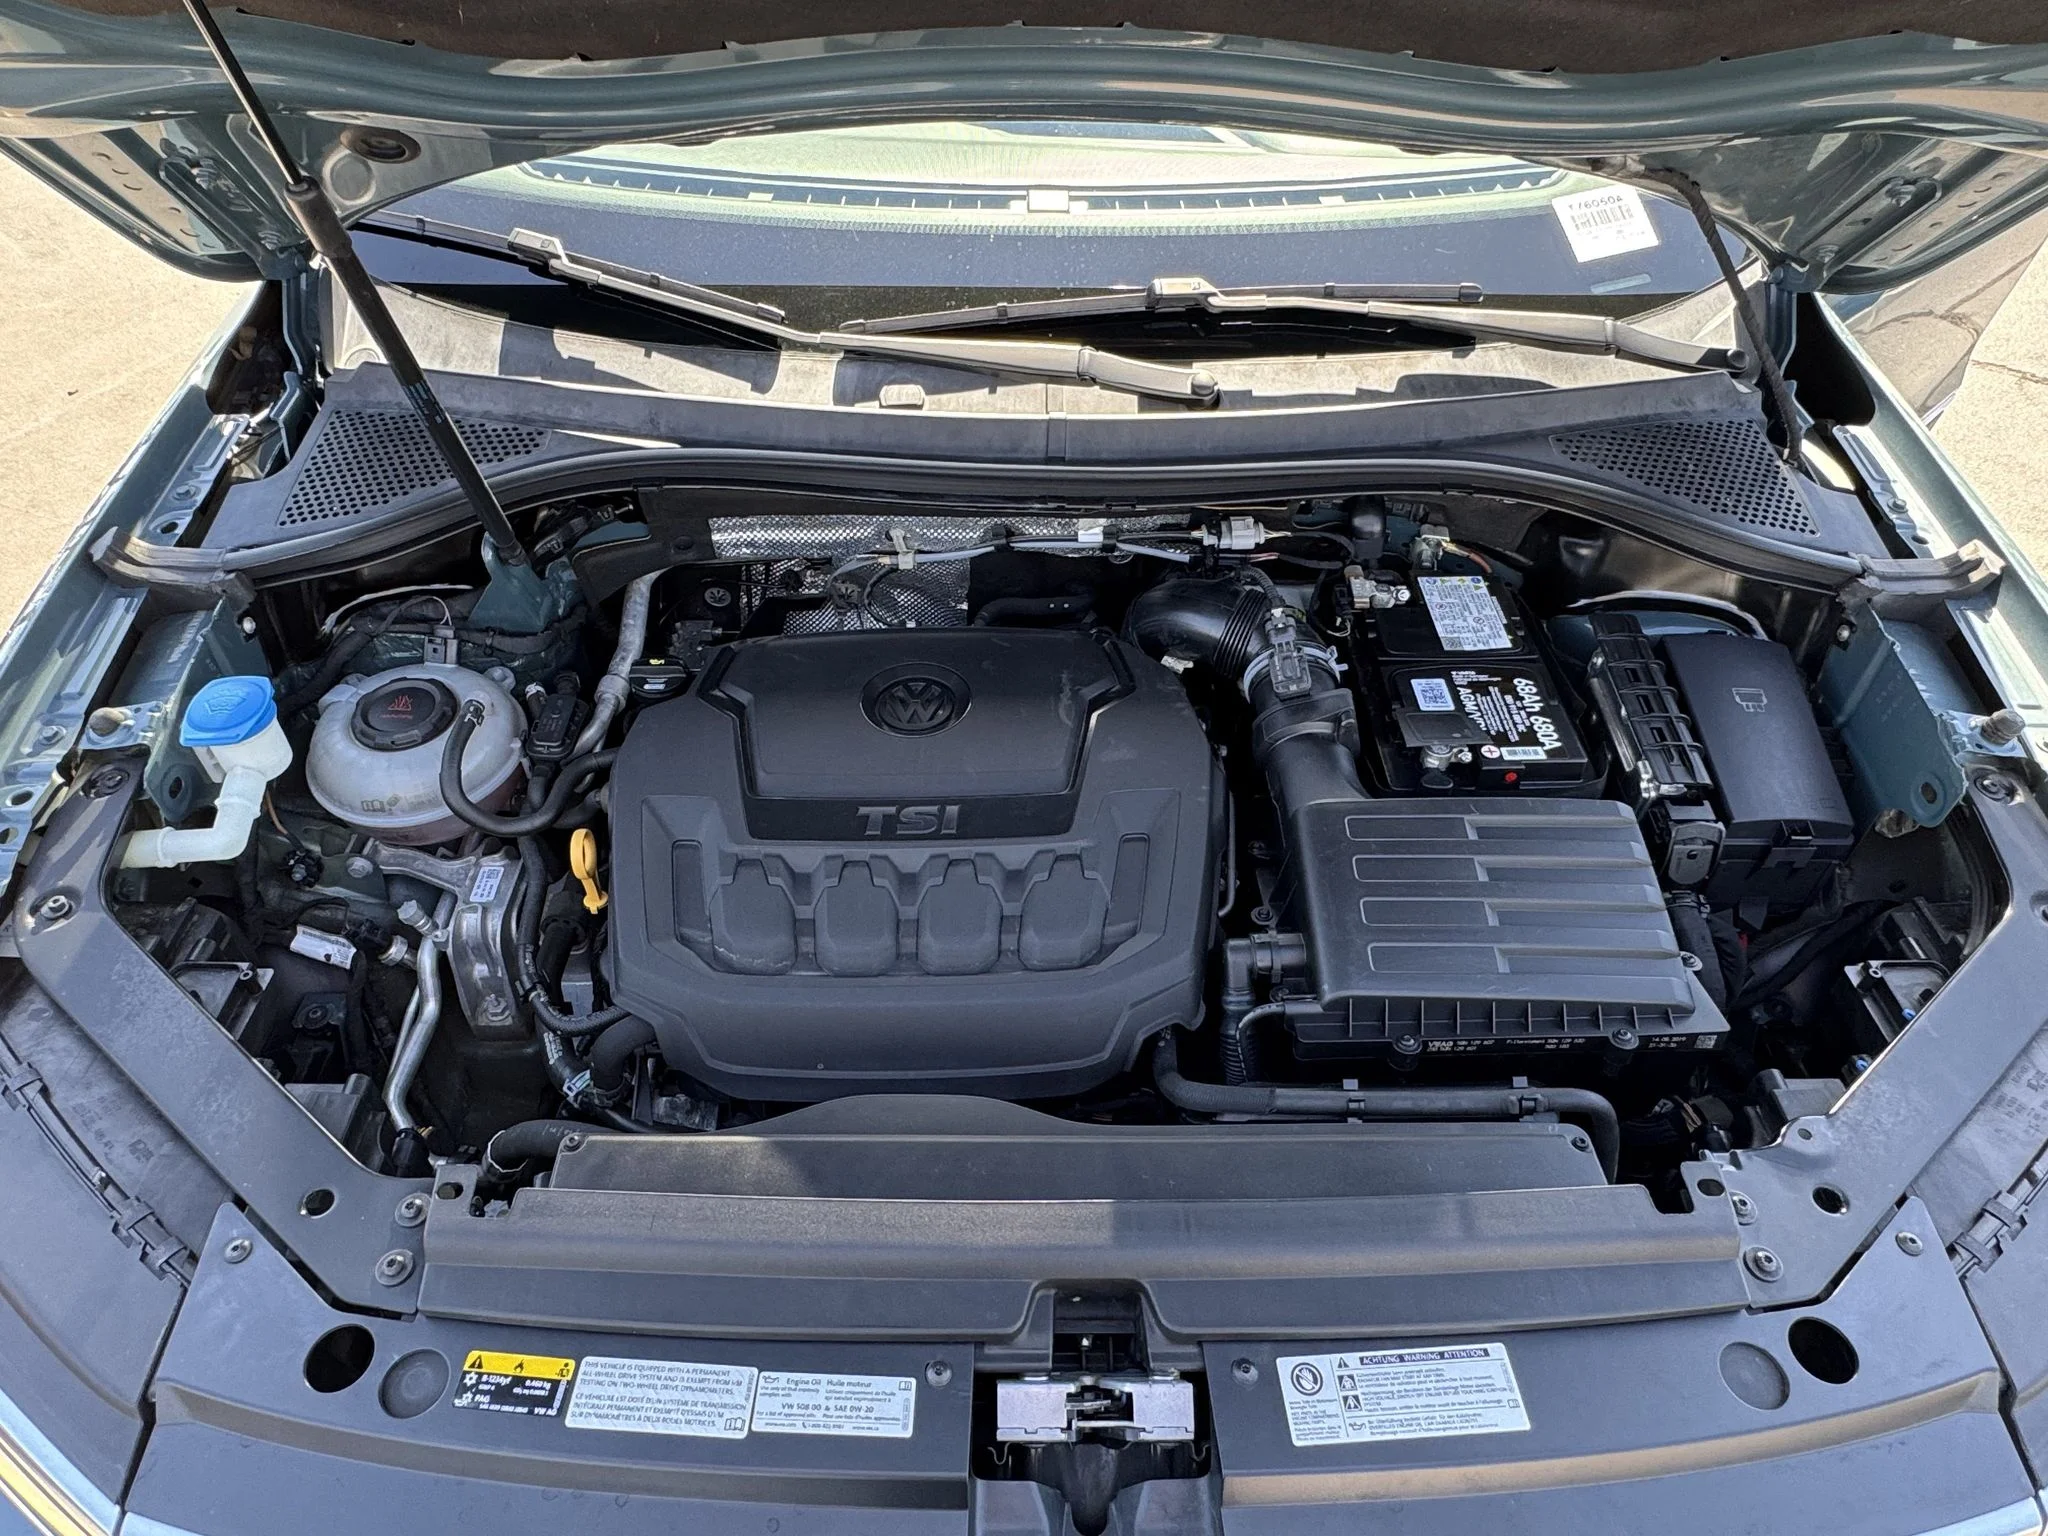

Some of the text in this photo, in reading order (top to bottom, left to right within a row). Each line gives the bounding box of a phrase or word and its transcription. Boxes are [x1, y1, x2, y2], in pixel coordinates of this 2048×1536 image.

[1513, 678, 1544, 712] 68Ah
[1530, 716, 1562, 750] 680A
[856, 804, 961, 835] TSI
[1363, 1349, 1485, 1365] ACHTUNG WARNING ATTENTION
[633, 1364, 665, 1372] EQUIPPED
[691, 1368, 729, 1376] PERMANENT
[659, 1383, 679, 1391] DRIVE
[786, 1377, 809, 1386] Engine
[795, 1402, 809, 1410] 508
